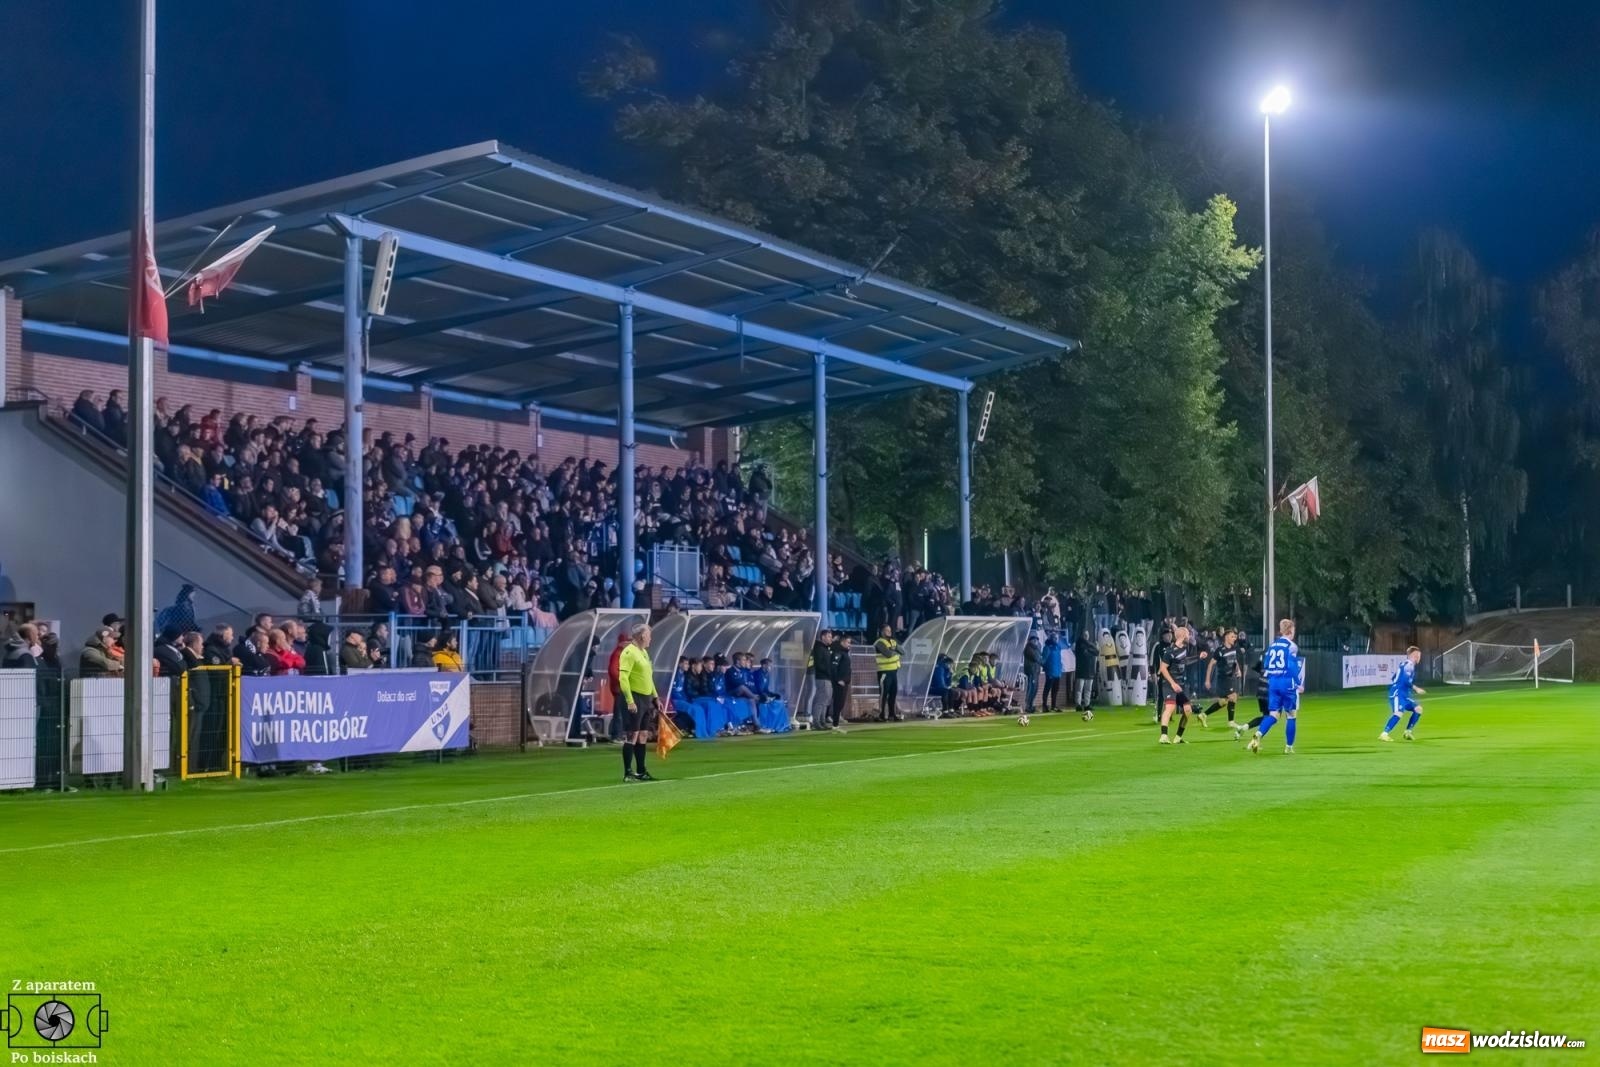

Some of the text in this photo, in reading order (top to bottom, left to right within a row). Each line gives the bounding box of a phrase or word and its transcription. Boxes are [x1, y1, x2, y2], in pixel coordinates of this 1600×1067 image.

[1268, 649, 1286, 669] 23
[251, 690, 334, 716] AKADEMIA
[251, 711, 369, 746] UNII RACIBÓRZ
